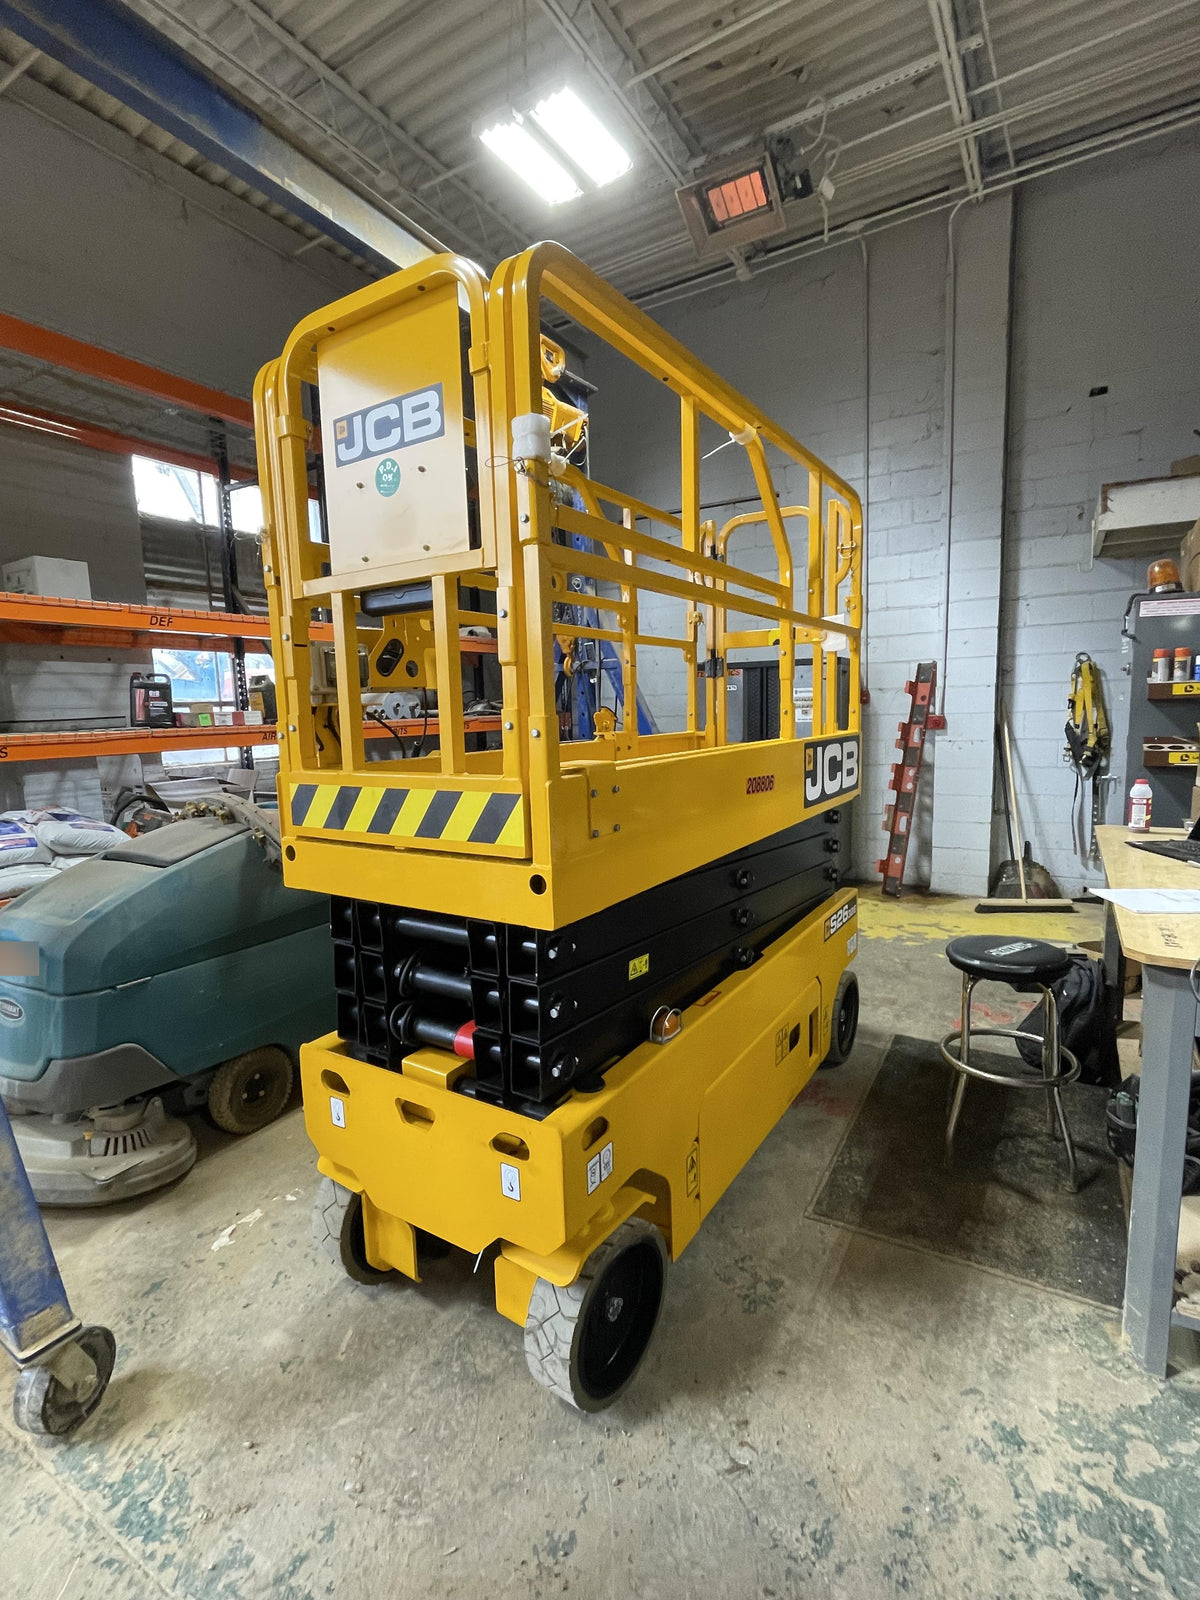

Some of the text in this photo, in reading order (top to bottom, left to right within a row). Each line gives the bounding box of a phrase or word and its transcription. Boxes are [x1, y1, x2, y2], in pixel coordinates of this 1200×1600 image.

[338, 391, 441, 461] JCB
[150, 615, 173, 627] DEF
[262, 732, 277, 740] AIR
[806, 740, 858, 801] JCB
